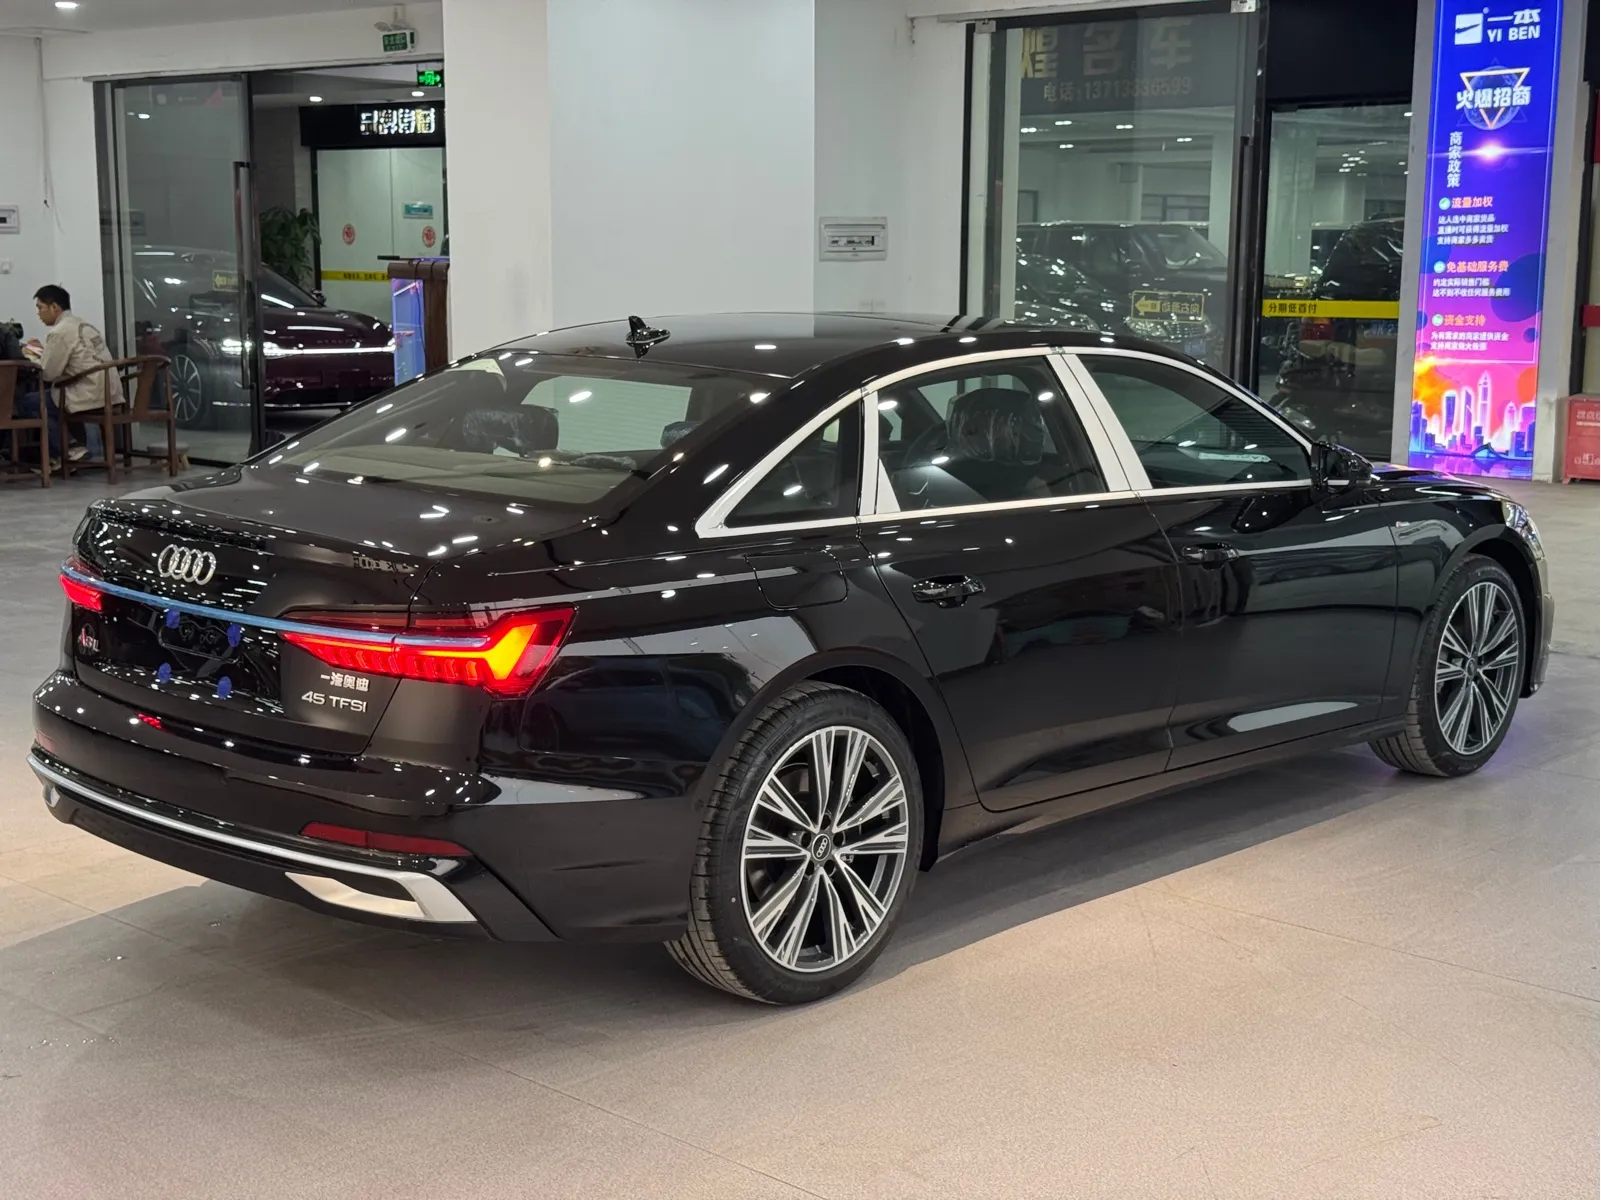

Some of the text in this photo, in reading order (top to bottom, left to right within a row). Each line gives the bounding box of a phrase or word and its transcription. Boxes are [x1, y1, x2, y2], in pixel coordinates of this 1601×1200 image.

[1487, 8, 1541, 25] 一本
[1487, 25, 1541, 43] YI BEN
[1455, 85, 1532, 111] 火爆招商
[1446, 131, 1464, 188] 商家政策
[1451, 196, 1494, 209] 流量加权
[1446, 260, 1509, 273] 免基础服务费
[1268, 303, 1318, 314] 分期低首付
[1443, 314, 1486, 327] 资金支持
[320, 671, 369, 692] 一汽奥迪
[301, 690, 368, 713] 45 TFSI
